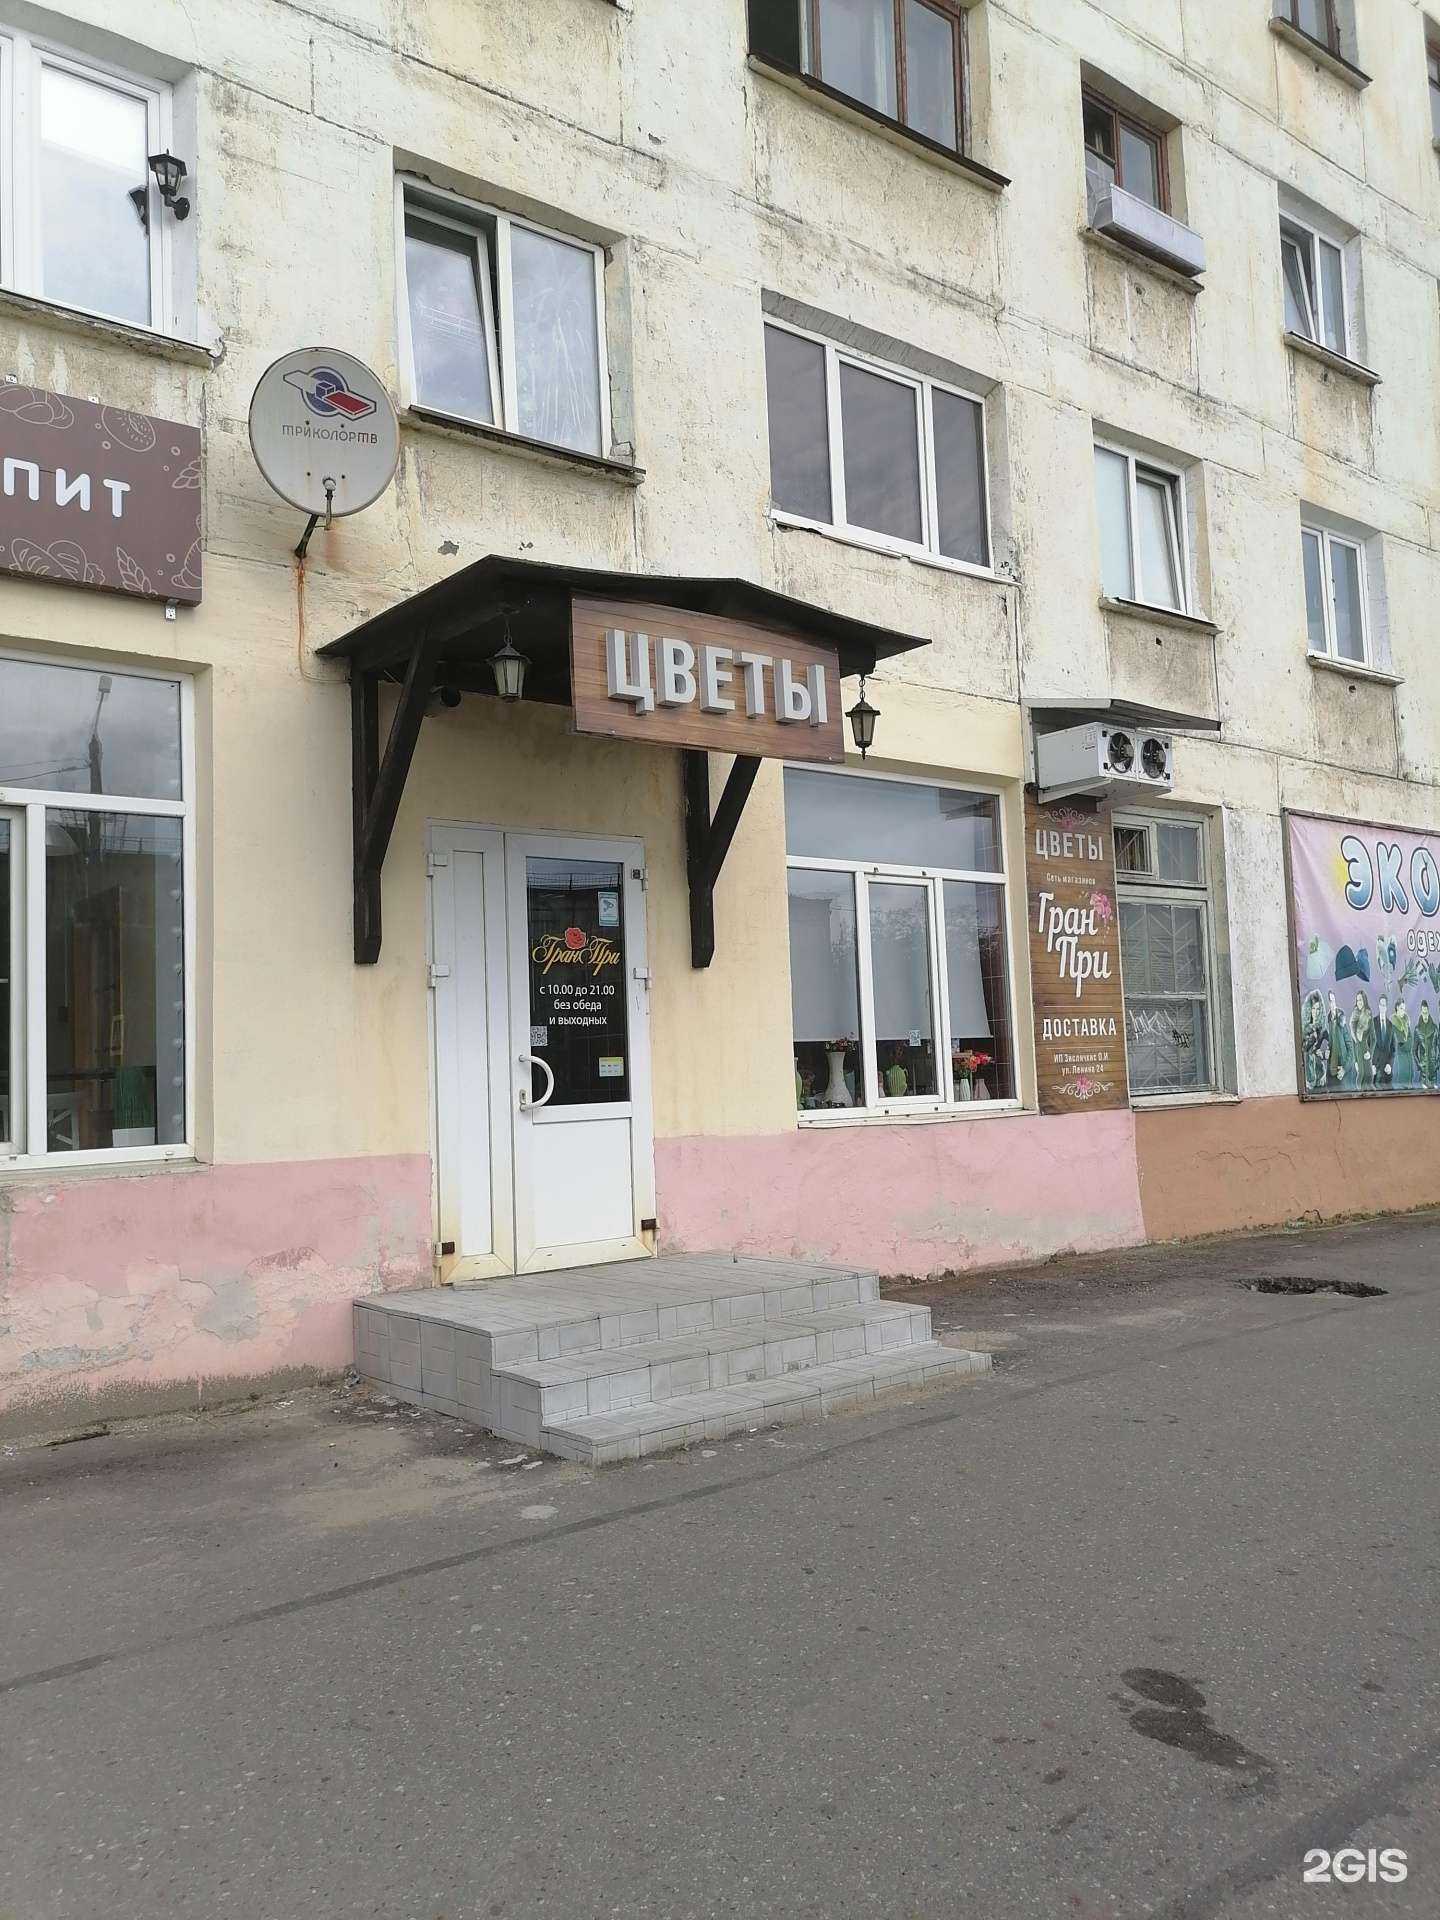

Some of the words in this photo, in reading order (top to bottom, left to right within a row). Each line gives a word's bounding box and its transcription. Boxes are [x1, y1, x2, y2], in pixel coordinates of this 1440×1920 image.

[3, 456, 131, 518] ПИТ
[606, 628, 828, 727] ЦВЕТЫ
[1035, 829, 1104, 861] ЦВЕТЫ
[1046, 872, 1062, 883] Сеть
[1038, 892, 1099, 953] Гран
[532, 934, 580, 975] Гран
[580, 935, 621, 976] При
[1055, 935, 1112, 998] При
[548, 984, 573, 995] 10.00
[574, 986, 588, 997] до
[589, 985, 615, 996] 21.00
[553, 998, 571, 1010] без
[572, 998, 602, 1012] обеда
[549, 1016, 556, 1025] и
[558, 1016, 608, 1027] выходных
[1042, 1017, 1117, 1041] ДОСТАВКА
